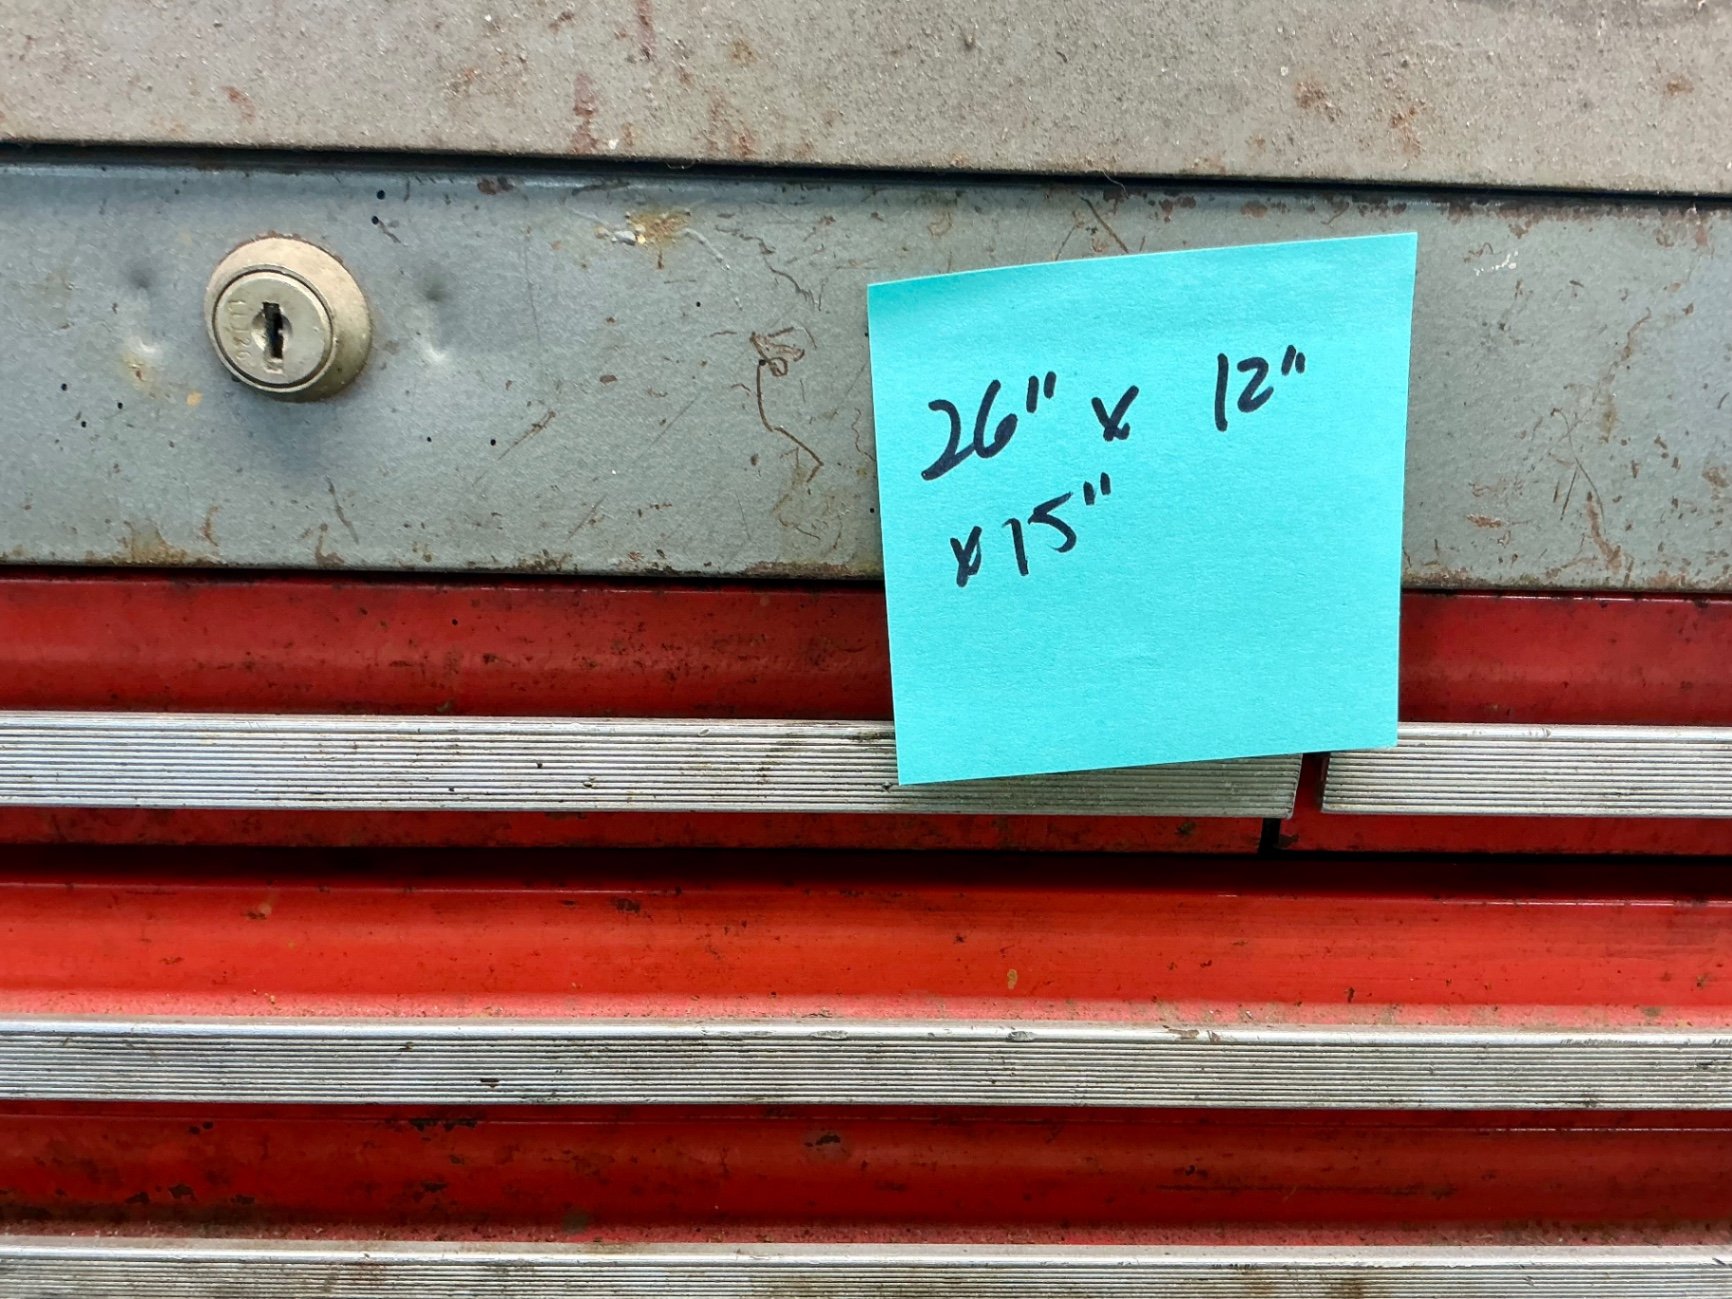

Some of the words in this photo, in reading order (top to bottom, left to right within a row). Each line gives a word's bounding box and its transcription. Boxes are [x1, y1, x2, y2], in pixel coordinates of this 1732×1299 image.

[920, 370, 1058, 481] 26"
[1090, 384, 1140, 442] x
[1213, 344, 1307, 433] 12"
